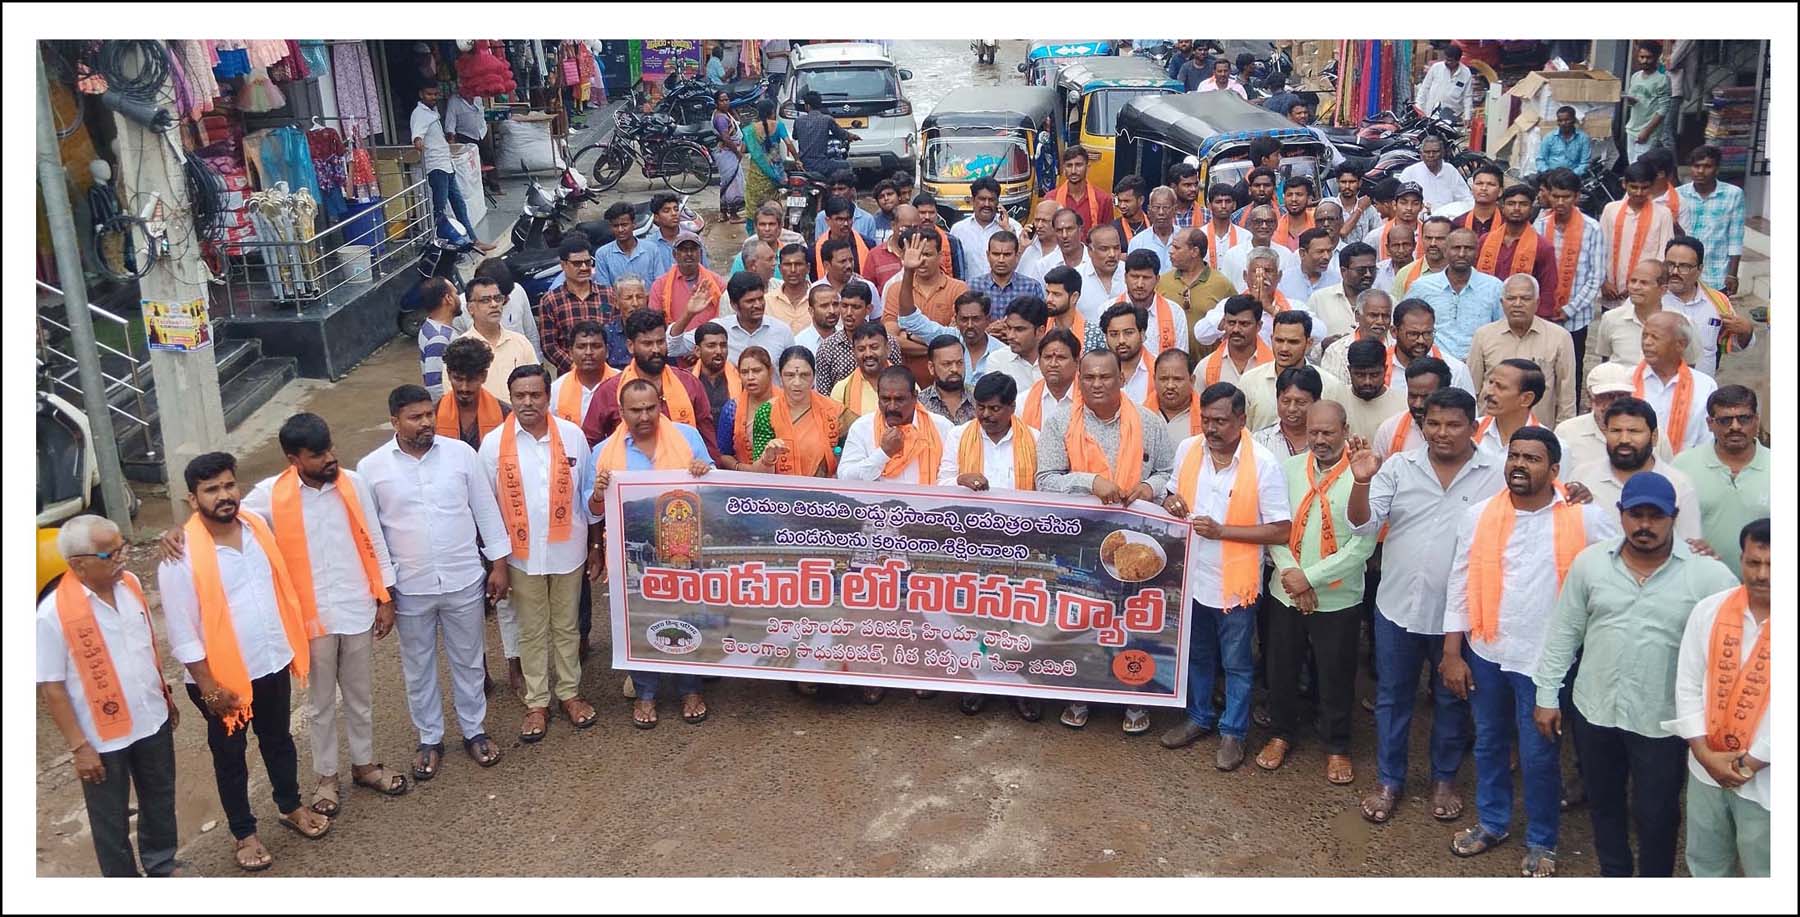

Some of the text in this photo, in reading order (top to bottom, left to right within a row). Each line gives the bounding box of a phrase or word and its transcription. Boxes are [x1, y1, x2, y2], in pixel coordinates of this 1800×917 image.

[727, 497, 1081, 536] తిరుమల తిరుపతి లడ్డు ప్రసాదాన్ని అపవిత్రం చేసిన
[775, 529, 868, 548] దుండగులను
[941, 537, 1029, 561] శిక్షించాలని
[642, 558, 1167, 647] తాండూర్ లో నిరసన ర్యాలీ
[922, 622, 977, 642] హిందూ
[983, 629, 1032, 652] వాహిని
[722, 638, 790, 659] తెలంగాణ
[893, 643, 919, 665] గీత
[988, 653, 1024, 673] సేవా
[1028, 658, 1078, 677] సమితి
